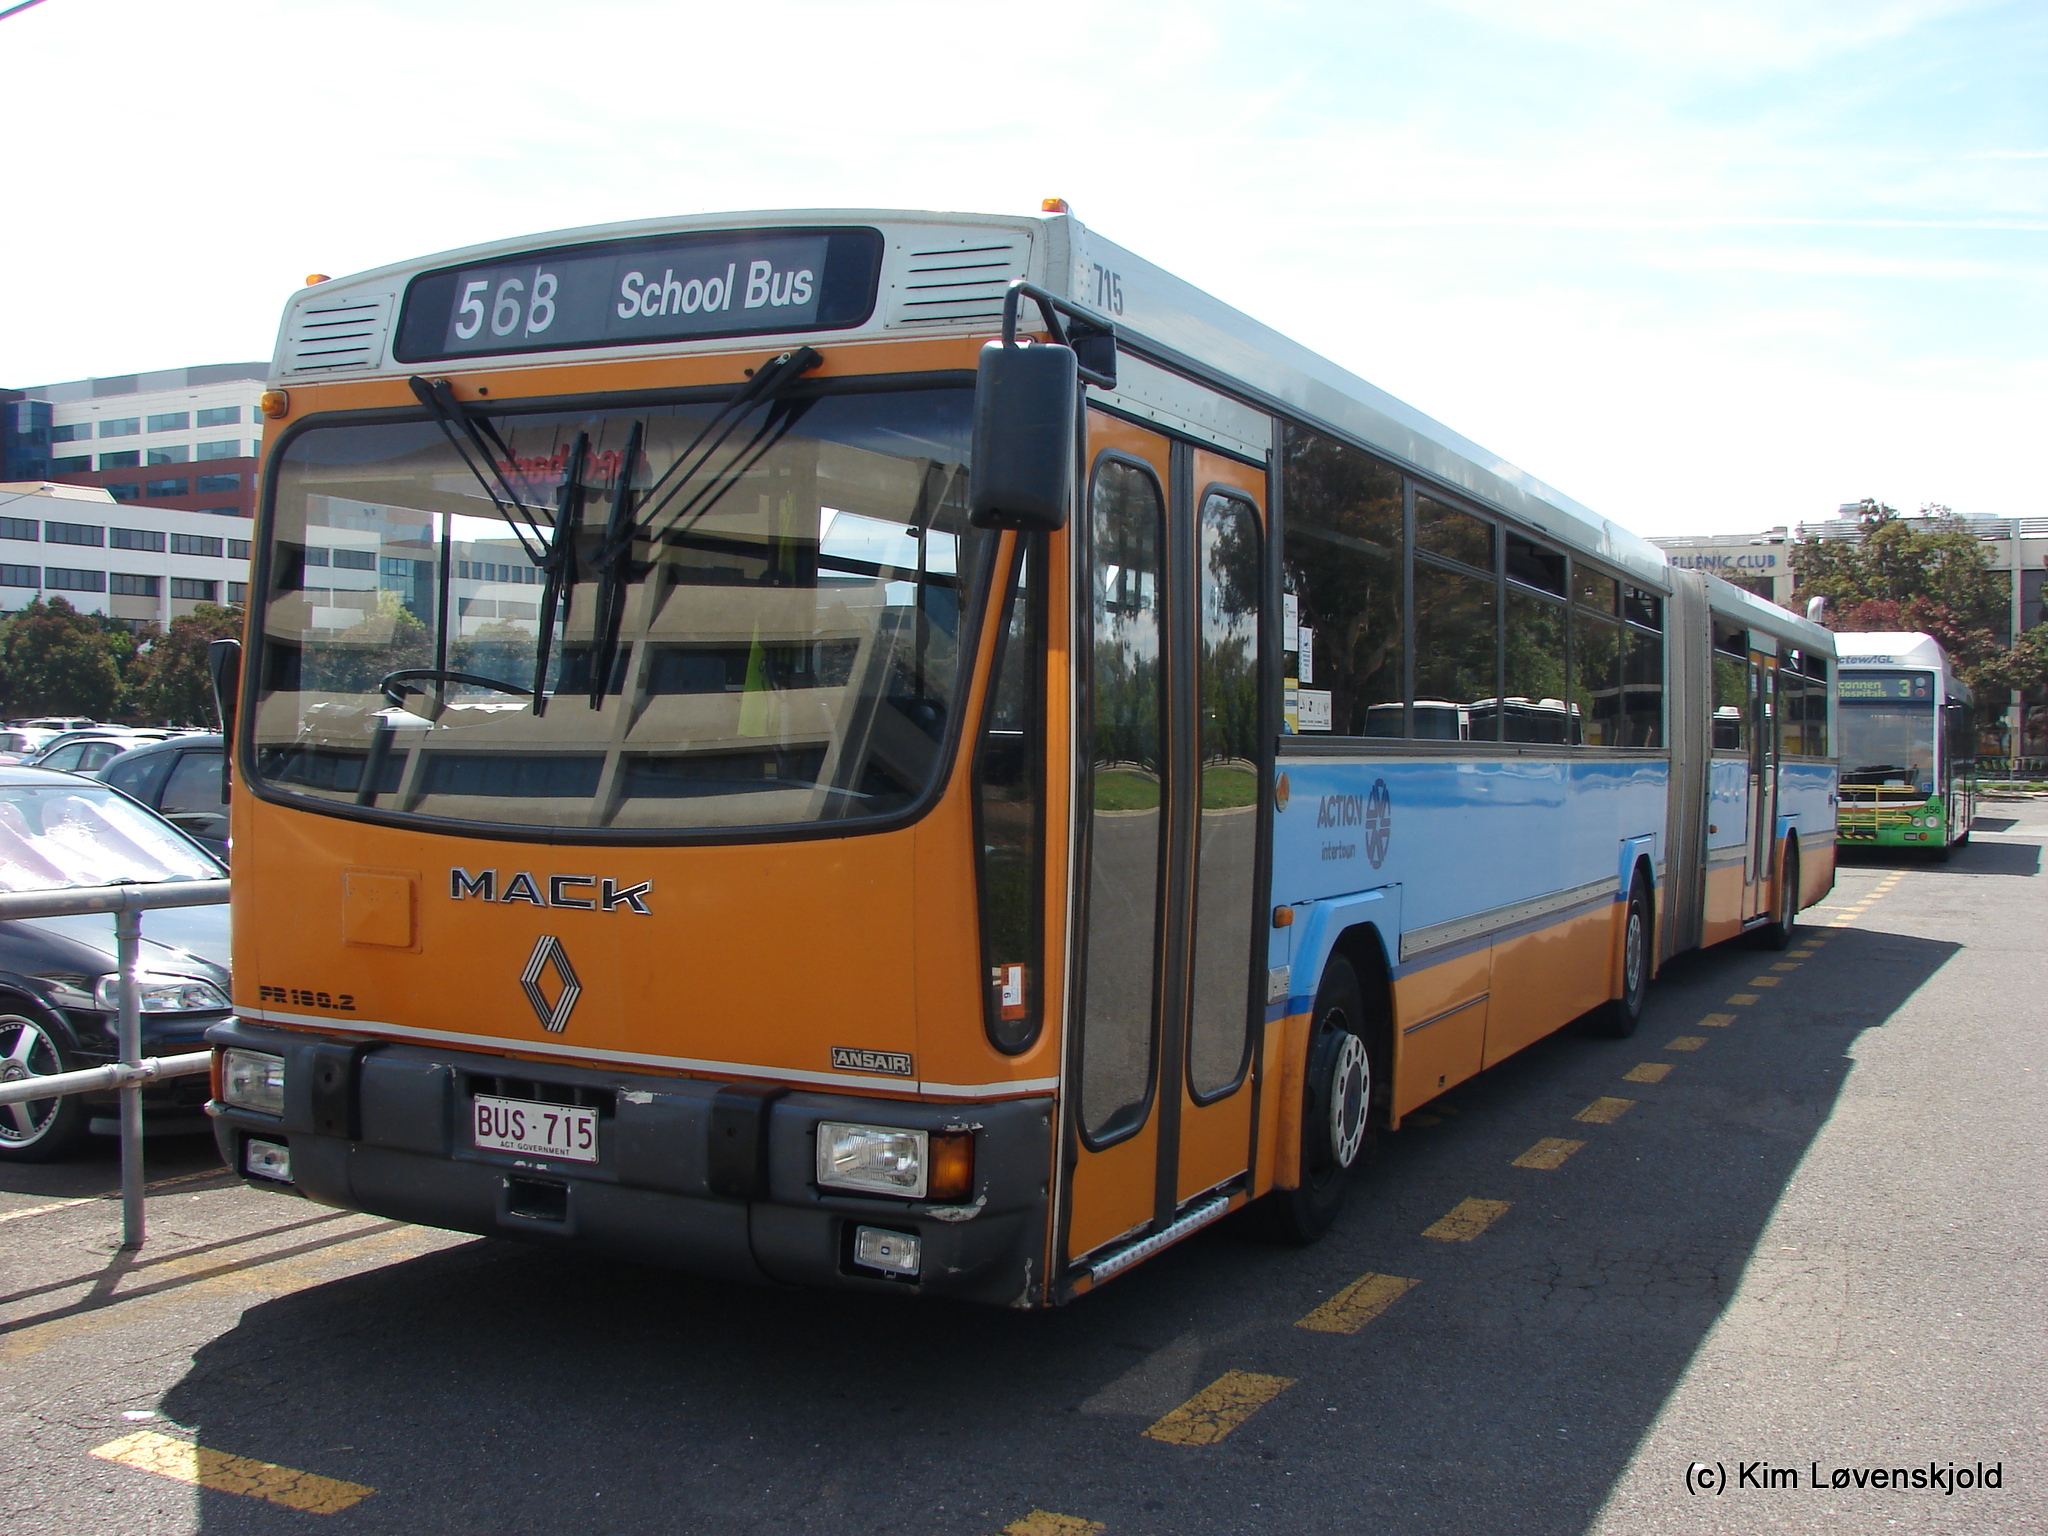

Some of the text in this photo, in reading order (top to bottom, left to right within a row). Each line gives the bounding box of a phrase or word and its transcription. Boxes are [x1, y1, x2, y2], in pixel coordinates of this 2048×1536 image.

[617, 263, 735, 319] School
[744, 260, 814, 309] Bus
[1093, 263, 1123, 316] 715
[1737, 554, 1776, 568] CLUB
[1838, 655, 1894, 664] ctewAGL
[1837, 679, 1911, 697] connen 3
[1317, 794, 1363, 829] ACTION
[1924, 806, 1940, 814] 356
[450, 866, 653, 915] MACK
[836, 1051, 907, 1071] ANSAIR
[478, 1105, 592, 1149] BUS 715
[500, 1141, 570, 1156] ACT GOVERNMENT
